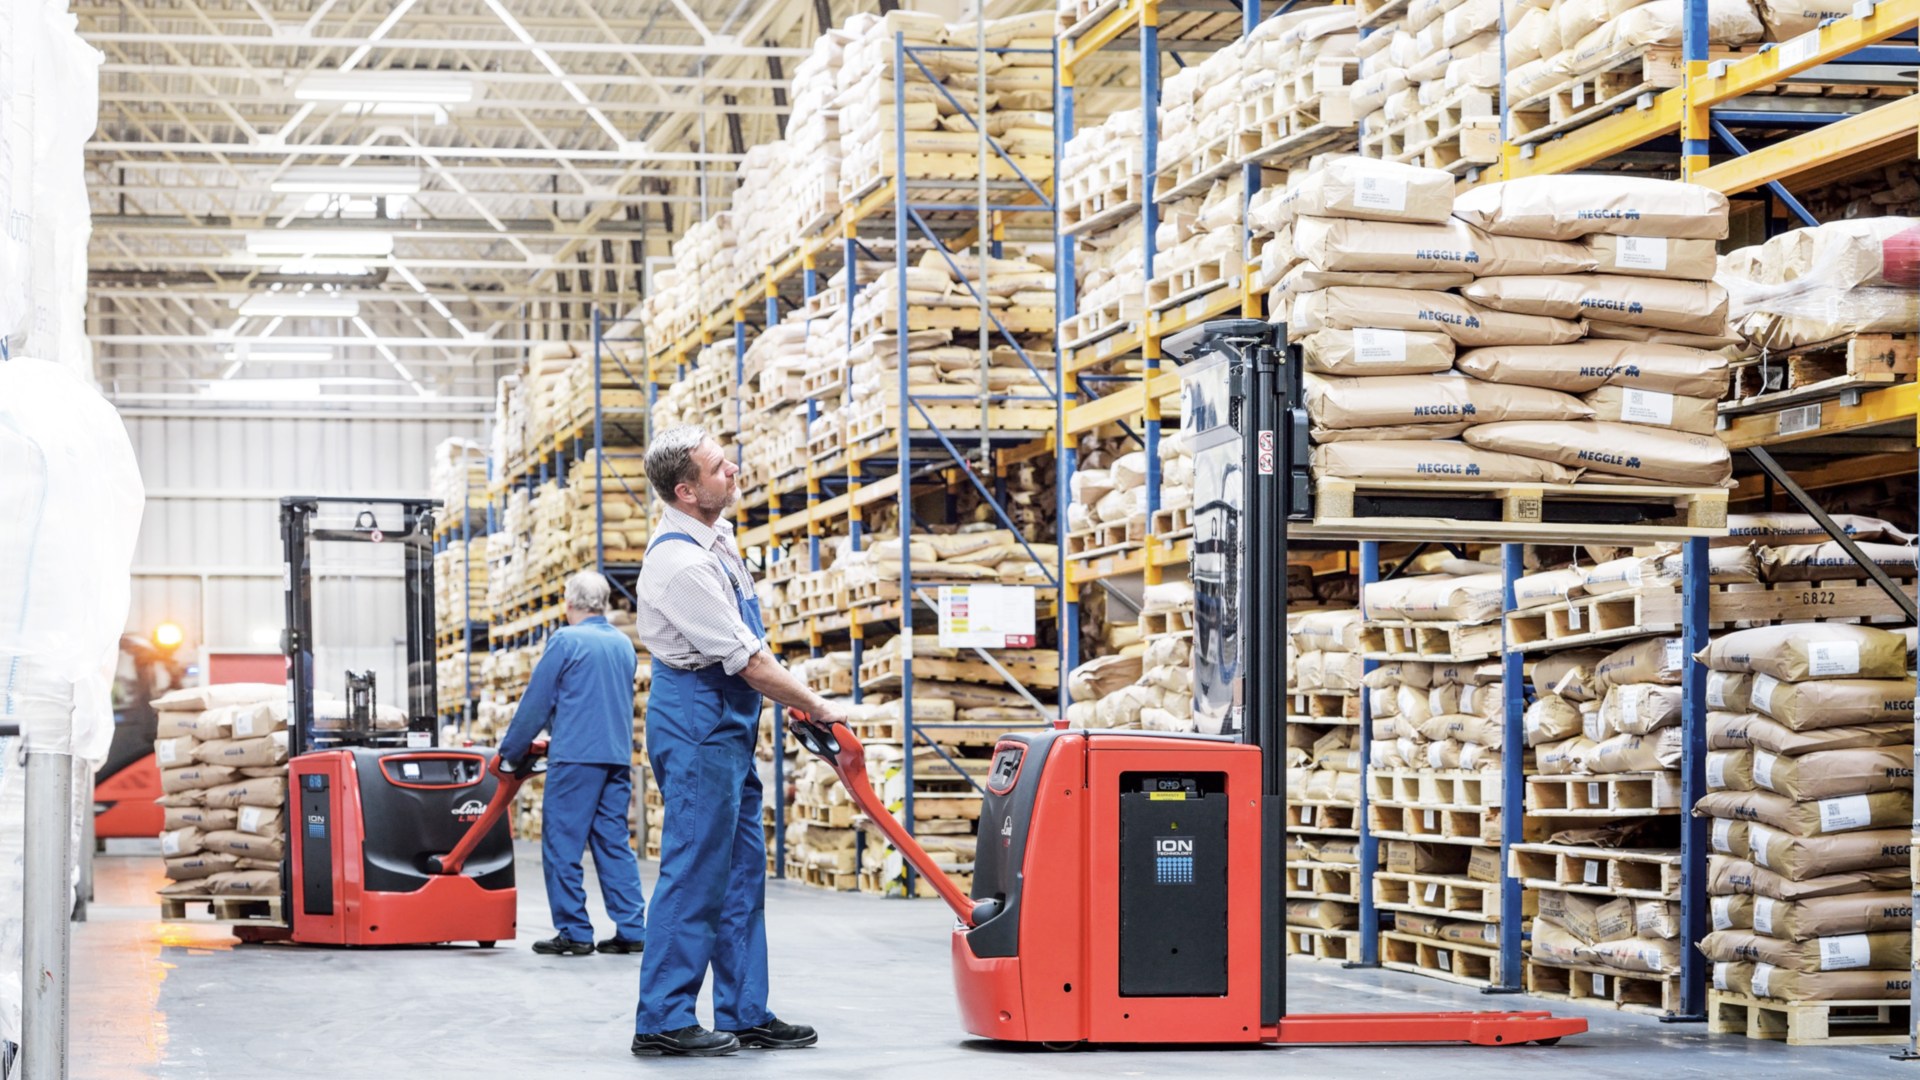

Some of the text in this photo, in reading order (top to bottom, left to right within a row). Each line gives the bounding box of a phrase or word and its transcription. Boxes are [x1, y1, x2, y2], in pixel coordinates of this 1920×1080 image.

[1417, 250, 1461, 261] MEGGLE
[1581, 299, 1625, 311] MEGGLE
[1419, 310, 1462, 325] MEGGLE
[1414, 405, 1458, 416] MEGGLE
[1578, 450, 1623, 465] MEGGLE
[1417, 463, 1462, 474] MEGGLE
[308, 815, 325, 823] ION
[1156, 840, 1193, 851] ION
